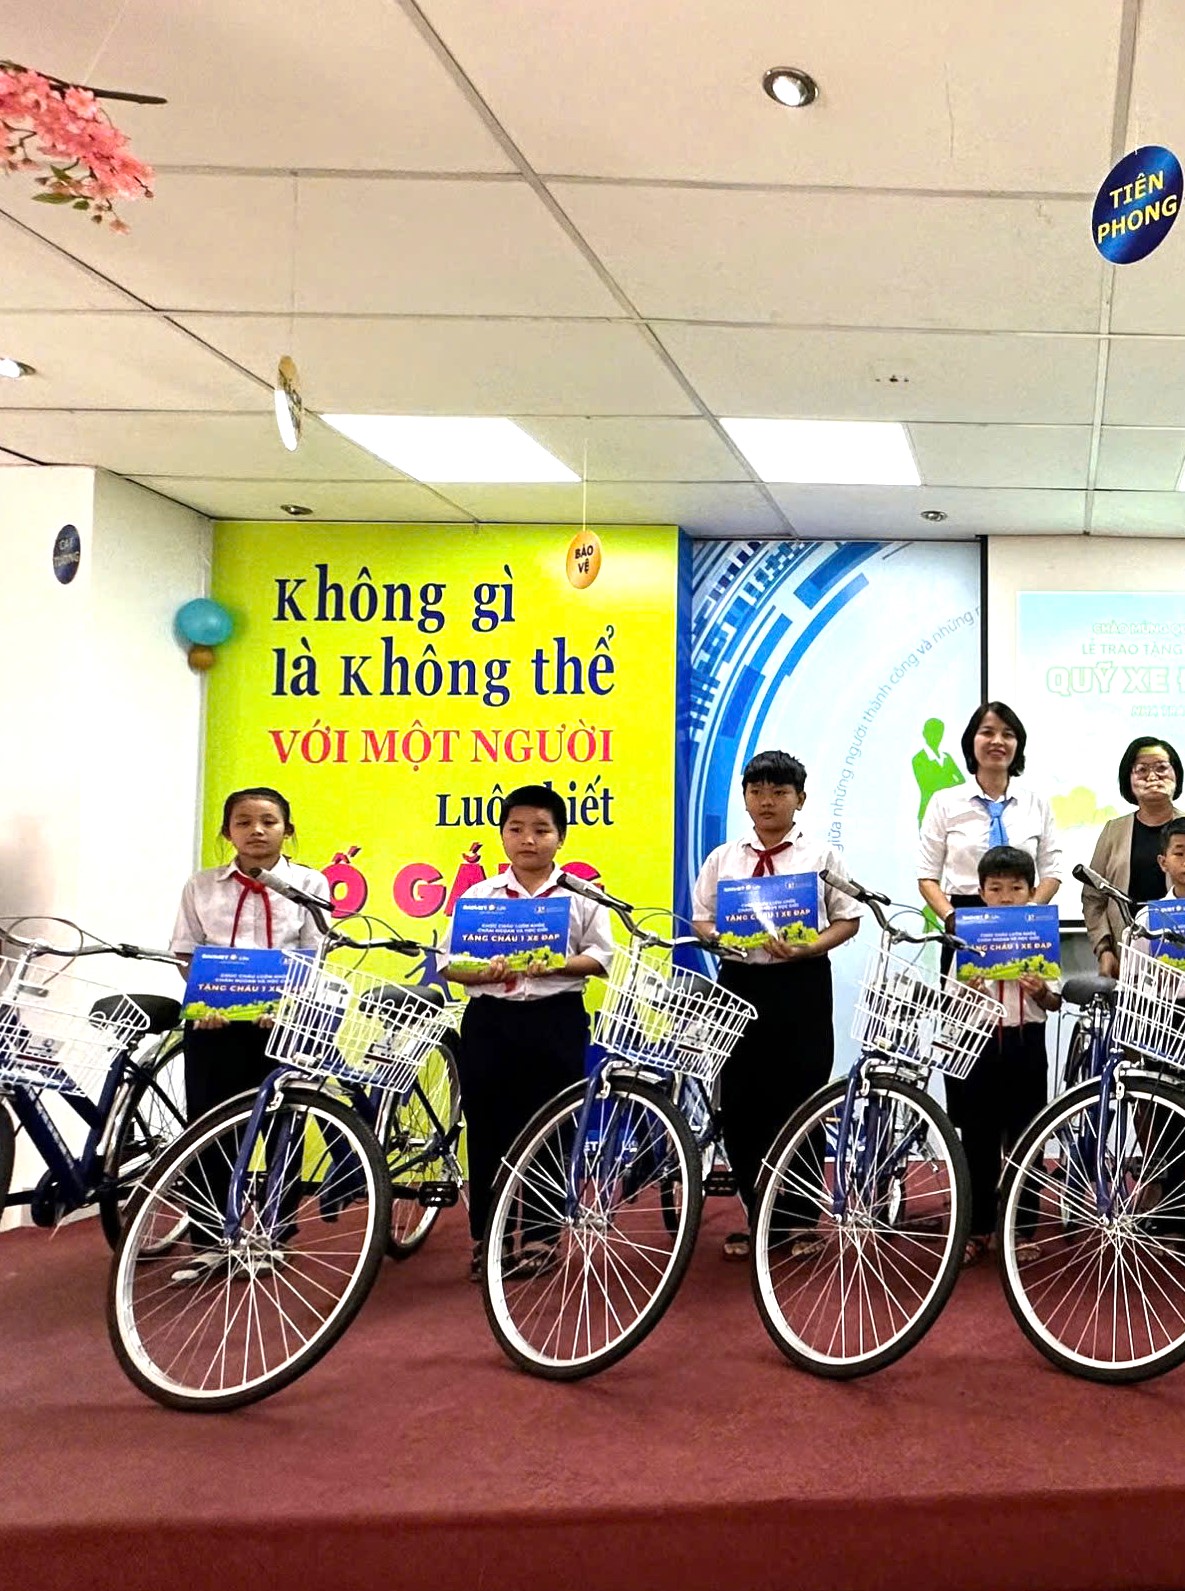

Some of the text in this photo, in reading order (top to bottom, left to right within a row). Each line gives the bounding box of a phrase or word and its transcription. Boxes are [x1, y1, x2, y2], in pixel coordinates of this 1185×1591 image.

[1109, 170, 1164, 209] TIÊN
[1097, 194, 1177, 244] PHONG
[472, 564, 516, 634] gì
[271, 636, 320, 697] là
[531, 624, 615, 696] thể
[1046, 660, 1118, 698] QUỸ
[1122, 666, 1170, 694] XE
[830, 768, 855, 817] những
[845, 724, 868, 766] người
[862, 684, 892, 723] thành
[889, 653, 920, 685] công
[916, 639, 933, 655] và
[932, 611, 975, 643] những
[268, 718, 614, 771] VỚI MỘT NGƯỜI
[435, 775, 614, 827] Luô iết
[321, 845, 369, 919] Ố
[491, 933, 518, 942] CHÁU
[781, 910, 792, 918] XE
[990, 943, 1013, 951] CHÁU
[229, 982, 259, 993] CHÁU
